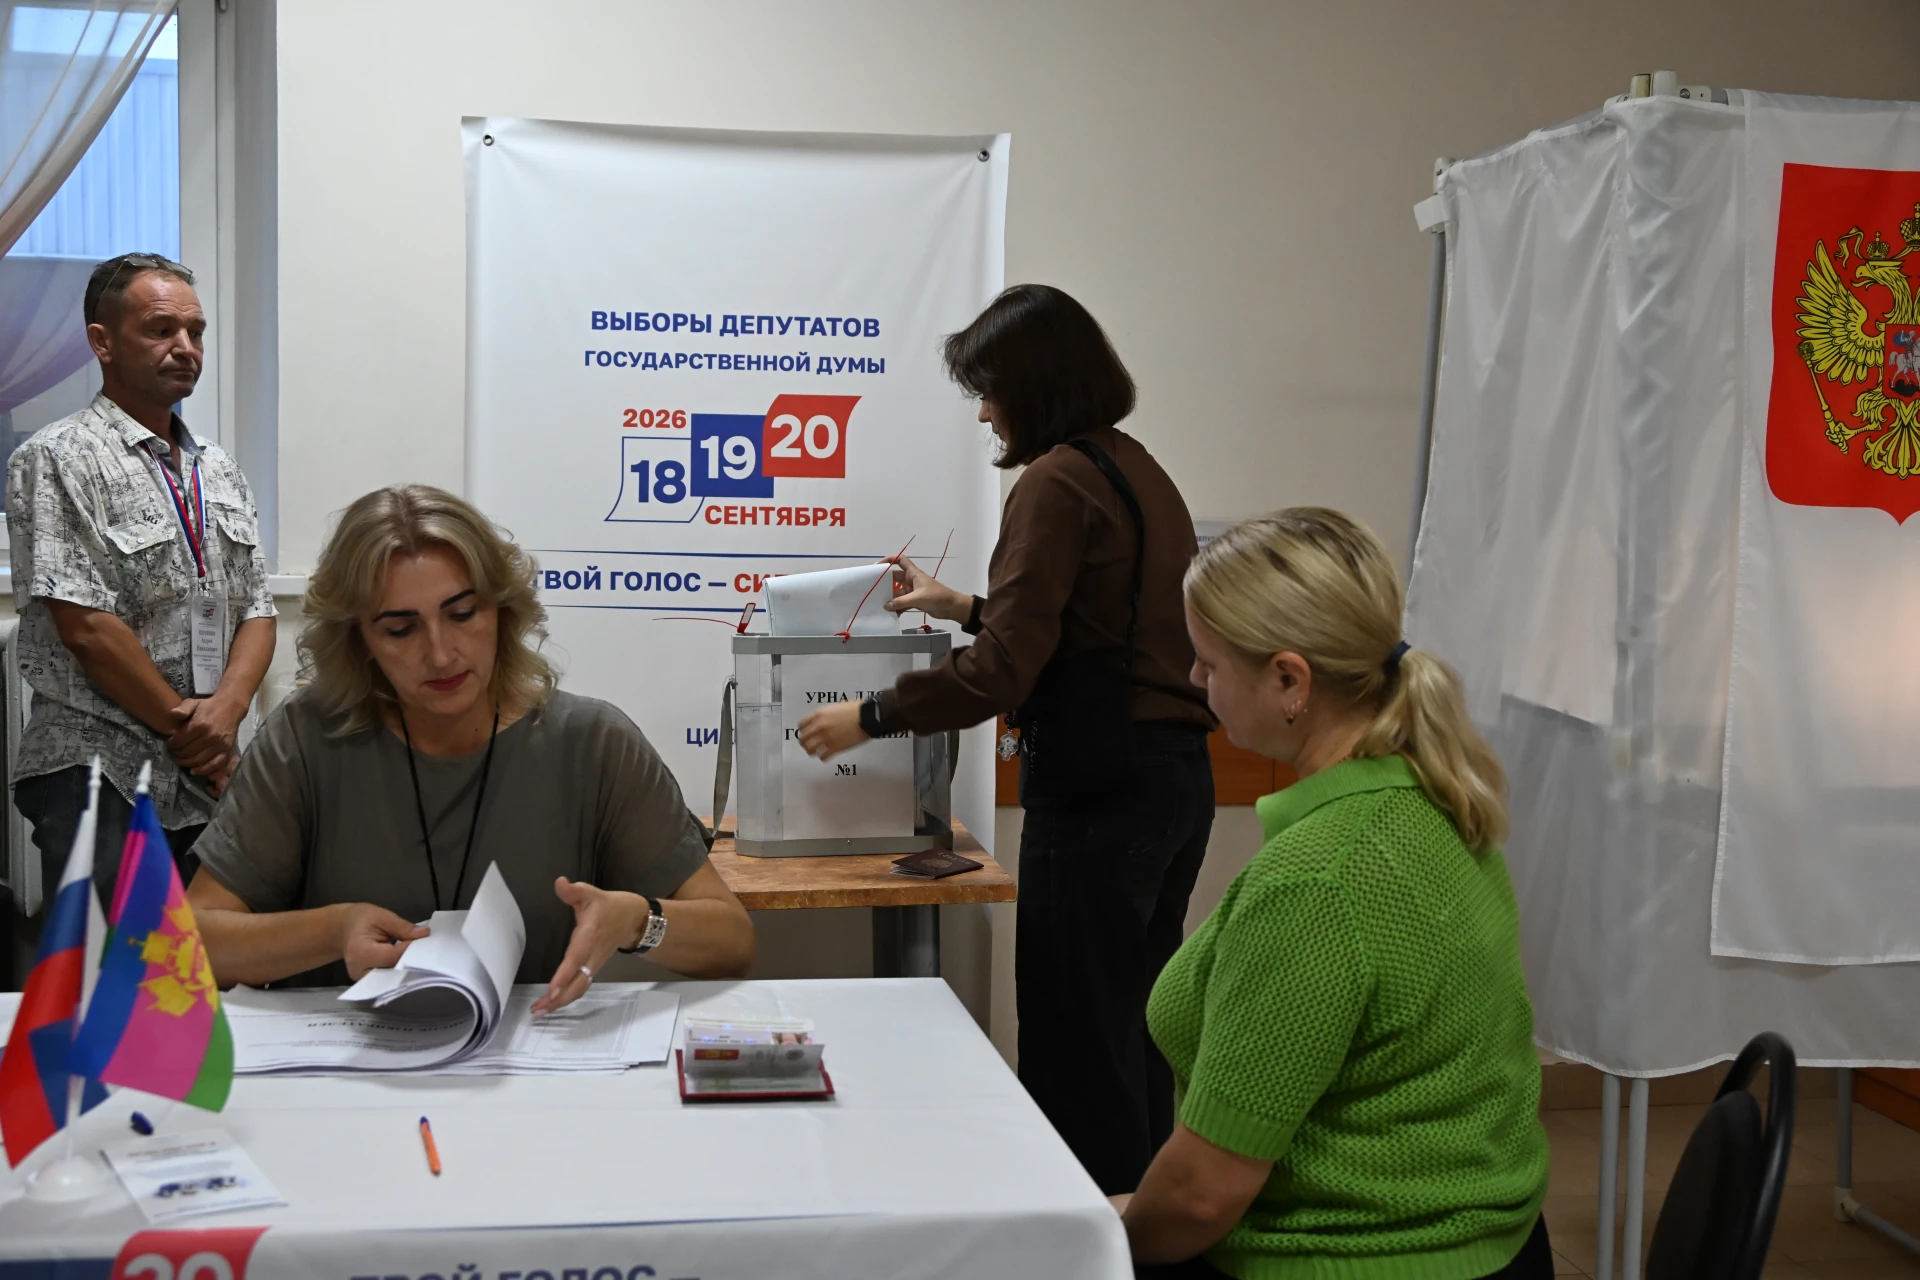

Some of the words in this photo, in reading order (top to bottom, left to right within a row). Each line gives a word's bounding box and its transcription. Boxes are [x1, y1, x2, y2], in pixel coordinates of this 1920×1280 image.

[591, 310, 712, 333] ВЫБОРЫ
[719, 315, 881, 338] ДЕПУТАТОВ
[584, 350, 810, 372] ГОСУДАРСТВЕННОЙ
[816, 356, 885, 375] ДУМЫ
[622, 408, 686, 429] 2026
[630, 460, 686, 504] 18
[700, 435, 756, 480] 19
[770, 413, 839, 459] 20
[704, 505, 846, 527] СЕНТЯБРЯ
[610, 571, 701, 592] ГОЛОС
[734, 573, 790, 593] СИ
[805, 691, 849, 703] УРНА
[686, 728, 735, 747] ЦИ
[835, 764, 857, 776] №1
